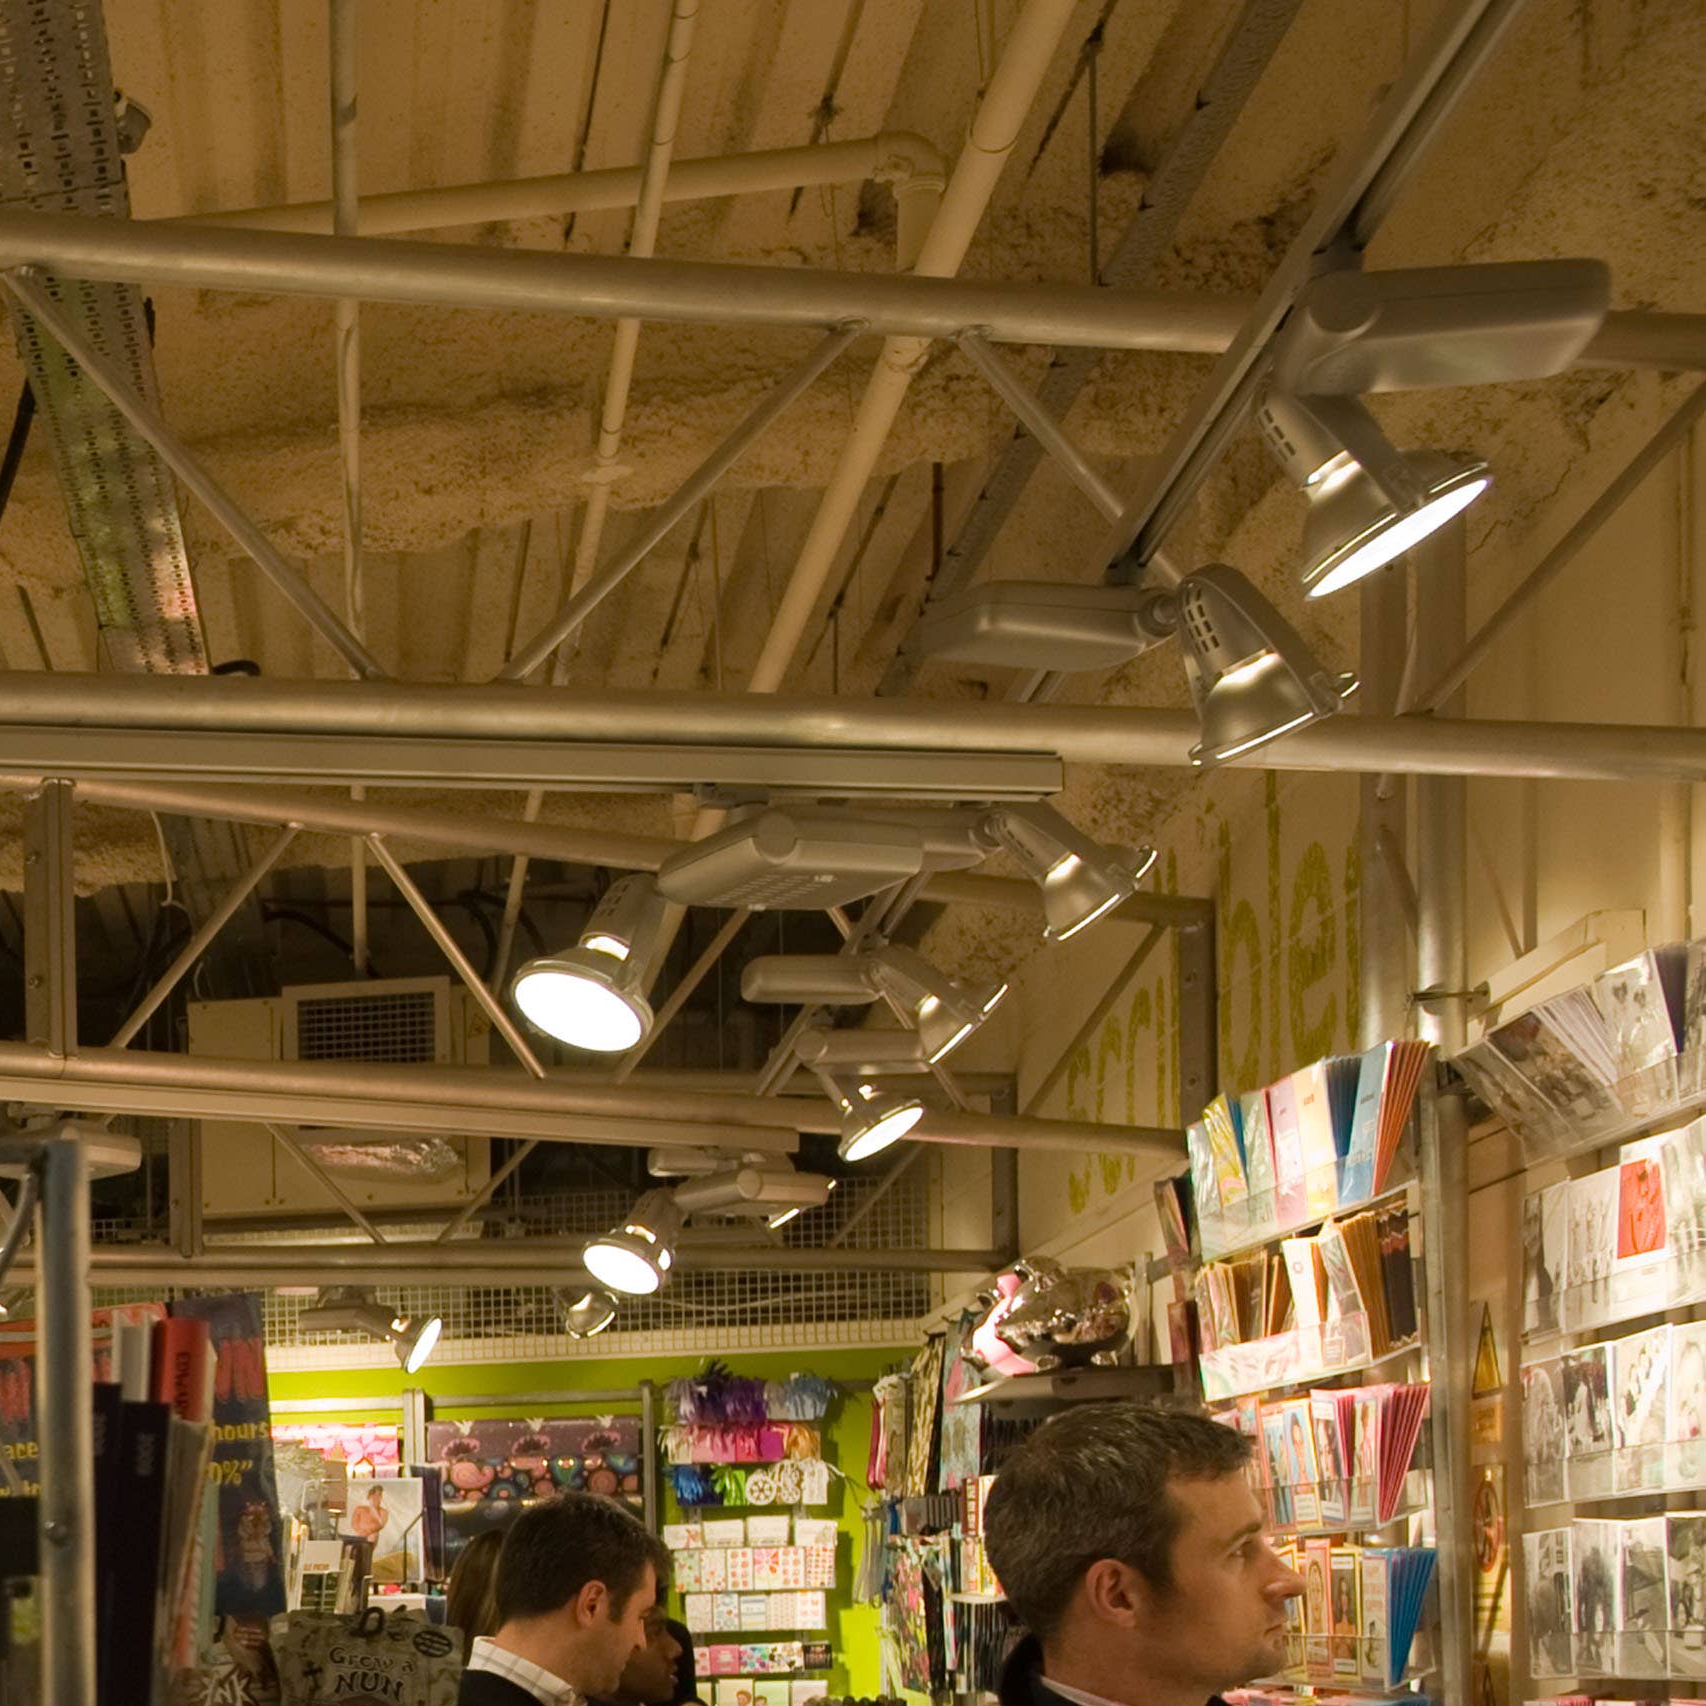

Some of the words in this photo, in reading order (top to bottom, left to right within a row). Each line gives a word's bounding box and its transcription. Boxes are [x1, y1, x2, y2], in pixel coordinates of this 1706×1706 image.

[329, 1646, 394, 1670] Grow
[401, 1660, 416, 1674] a
[333, 1671, 405, 1702] NUN
